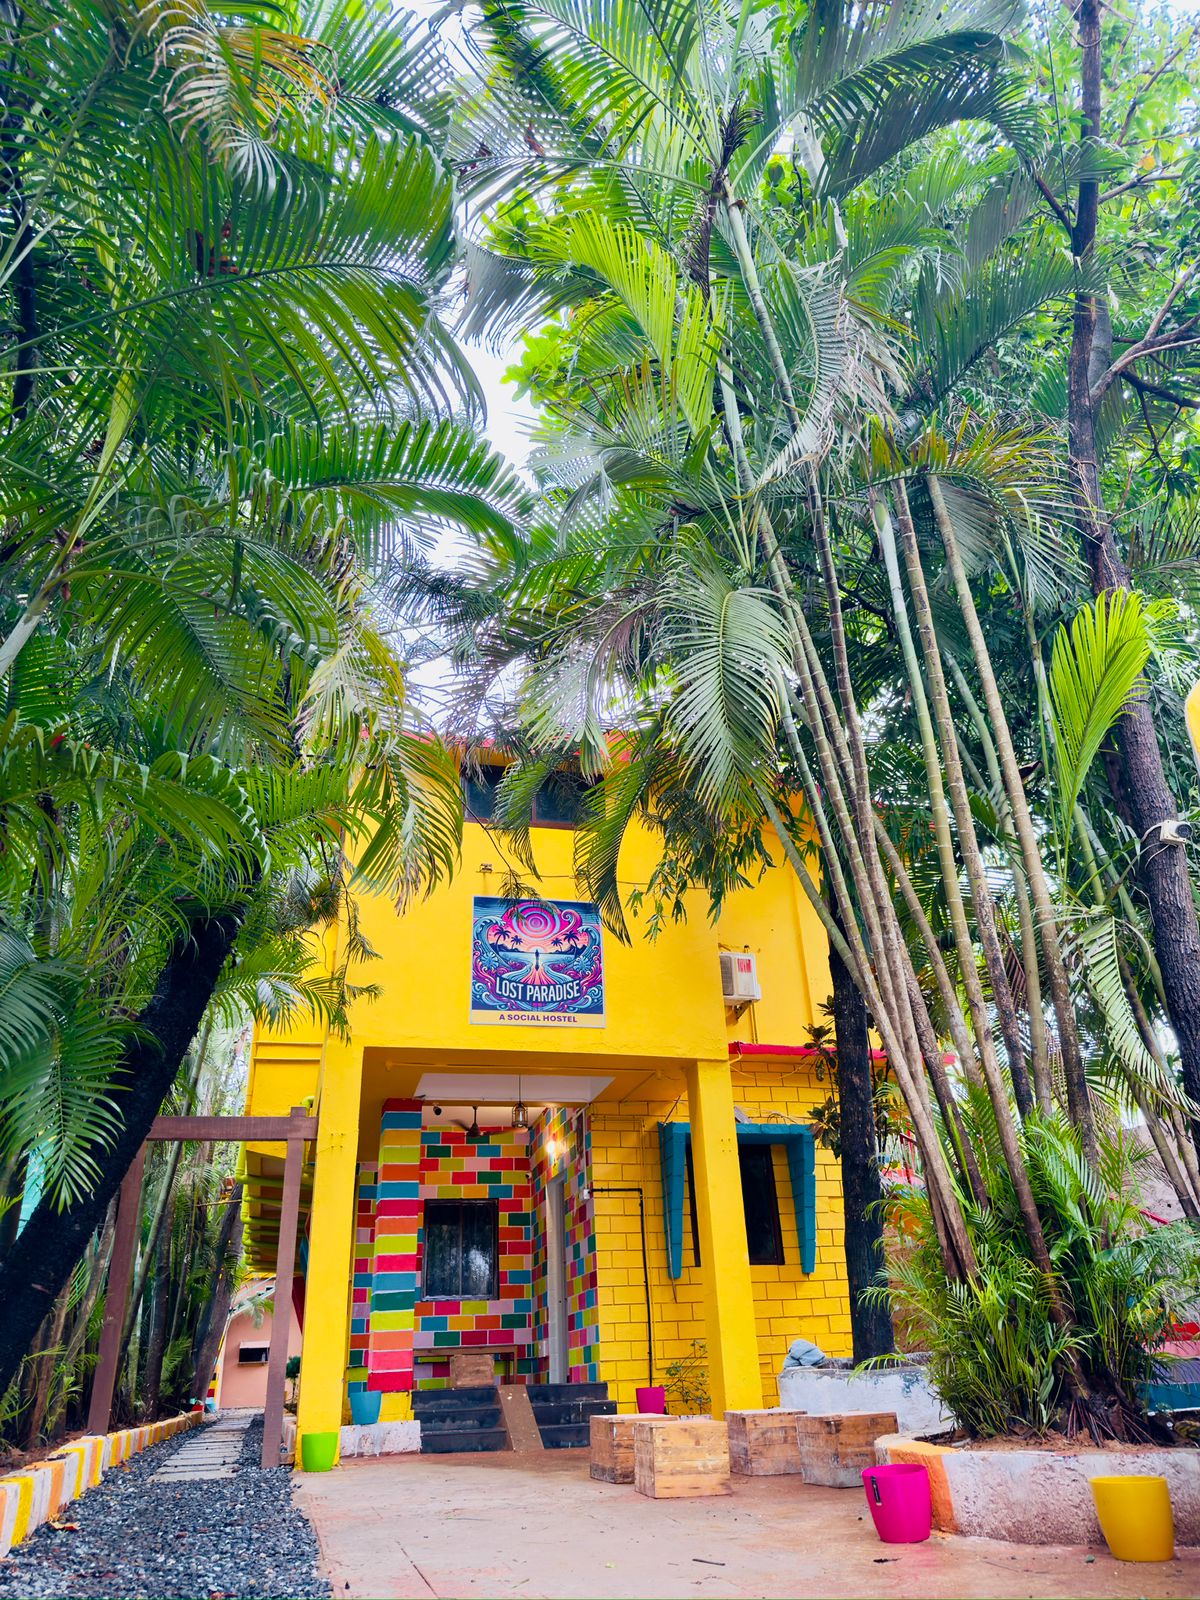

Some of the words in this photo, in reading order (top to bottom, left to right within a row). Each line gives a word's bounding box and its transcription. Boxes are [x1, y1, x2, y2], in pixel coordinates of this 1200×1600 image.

[495, 976, 524, 1000] LOST
[526, 980, 580, 1002] PARADISE
[507, 1014, 541, 1022] SOCIAL
[543, 1015, 578, 1023] HOSTEL
